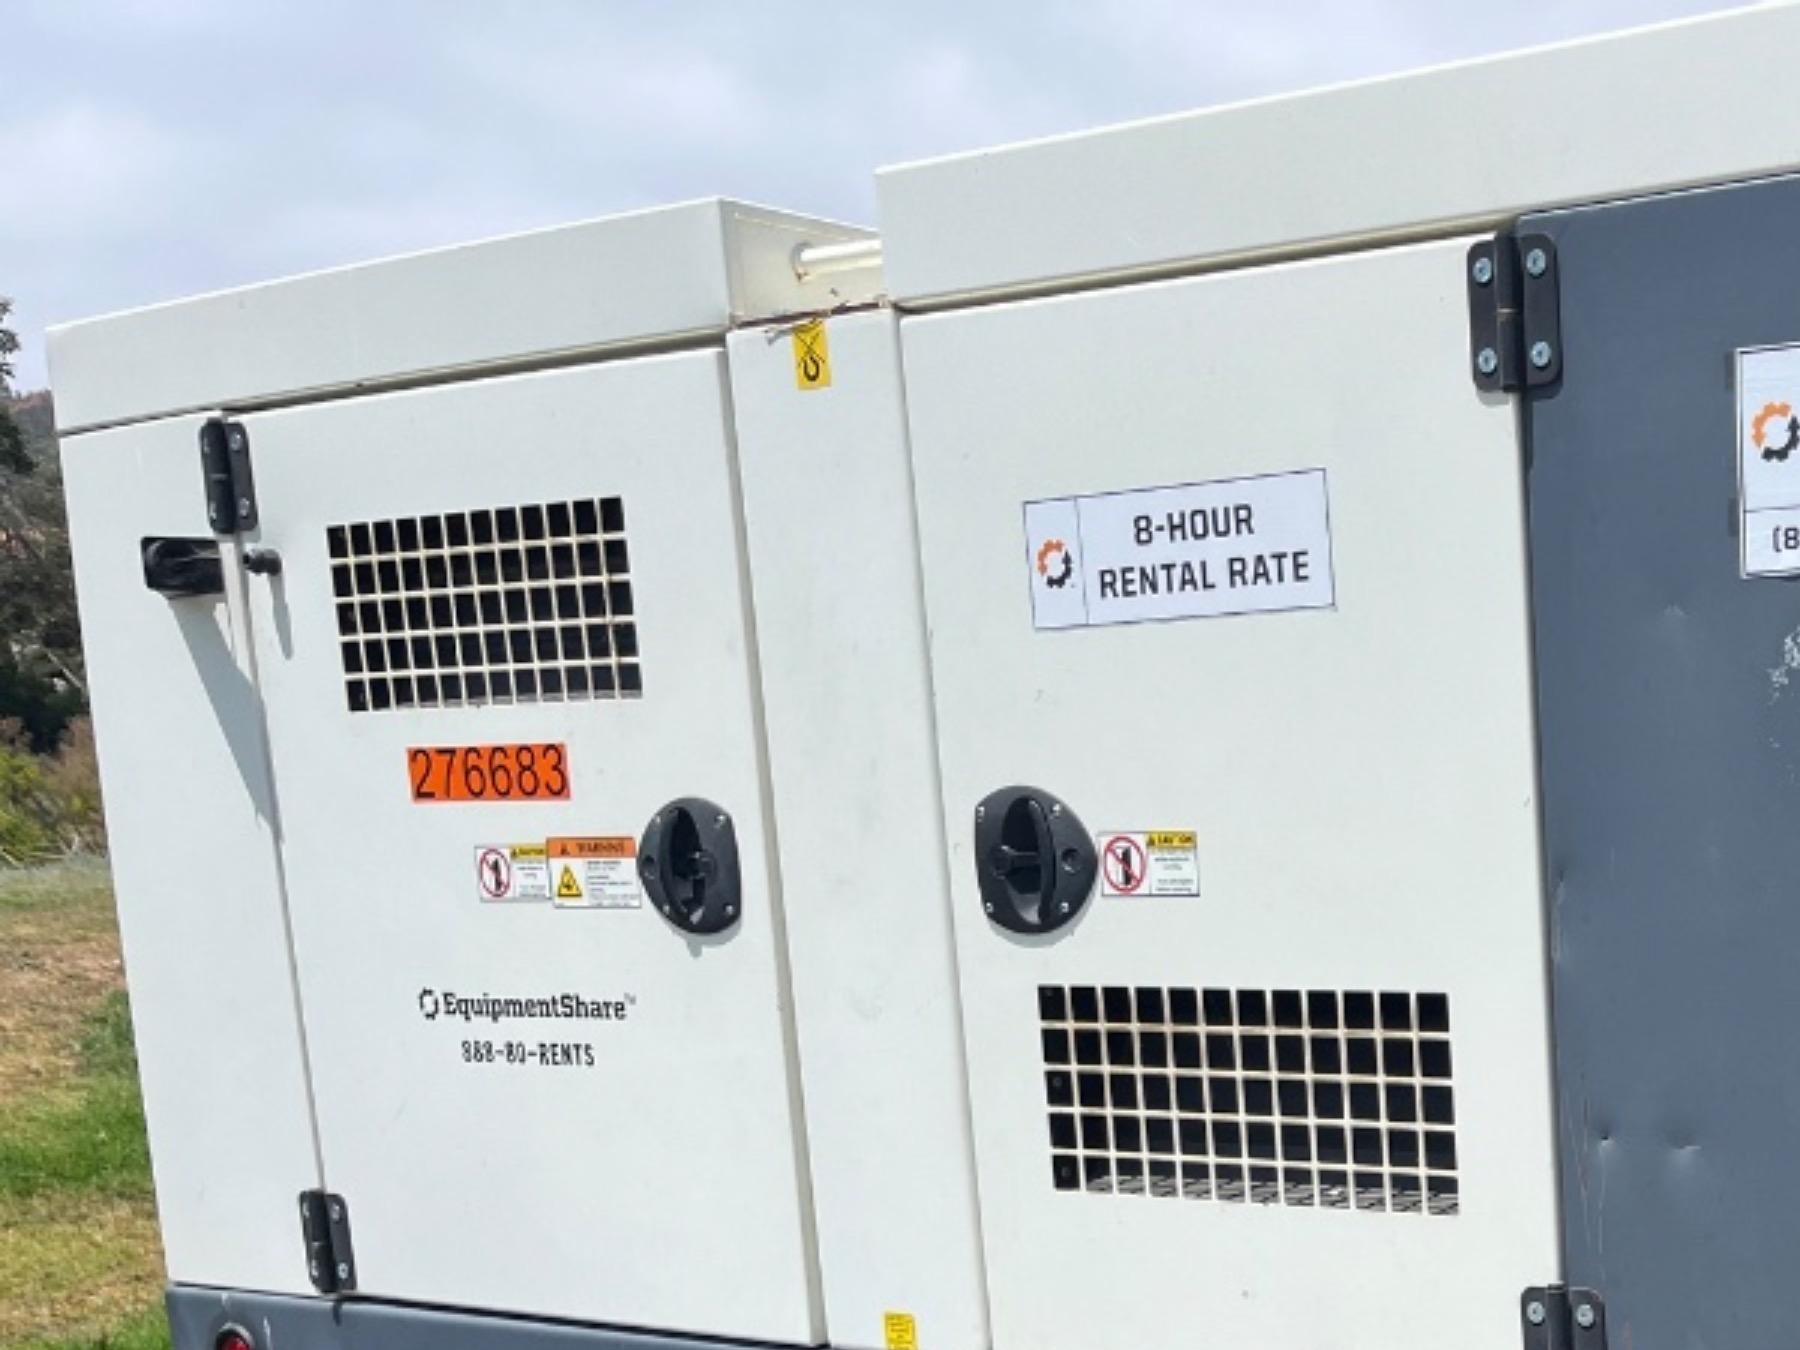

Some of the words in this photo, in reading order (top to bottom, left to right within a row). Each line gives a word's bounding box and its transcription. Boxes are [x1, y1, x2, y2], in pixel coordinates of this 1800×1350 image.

[1133, 504, 1255, 547] 8-HOUR
[1099, 559, 1216, 599] RENTAL
[1227, 550, 1310, 589] RATE
[411, 743, 566, 798] 276683
[442, 992, 627, 1023] EquipmentShare
[460, 1040, 595, 1067] 888-80-RENTS
